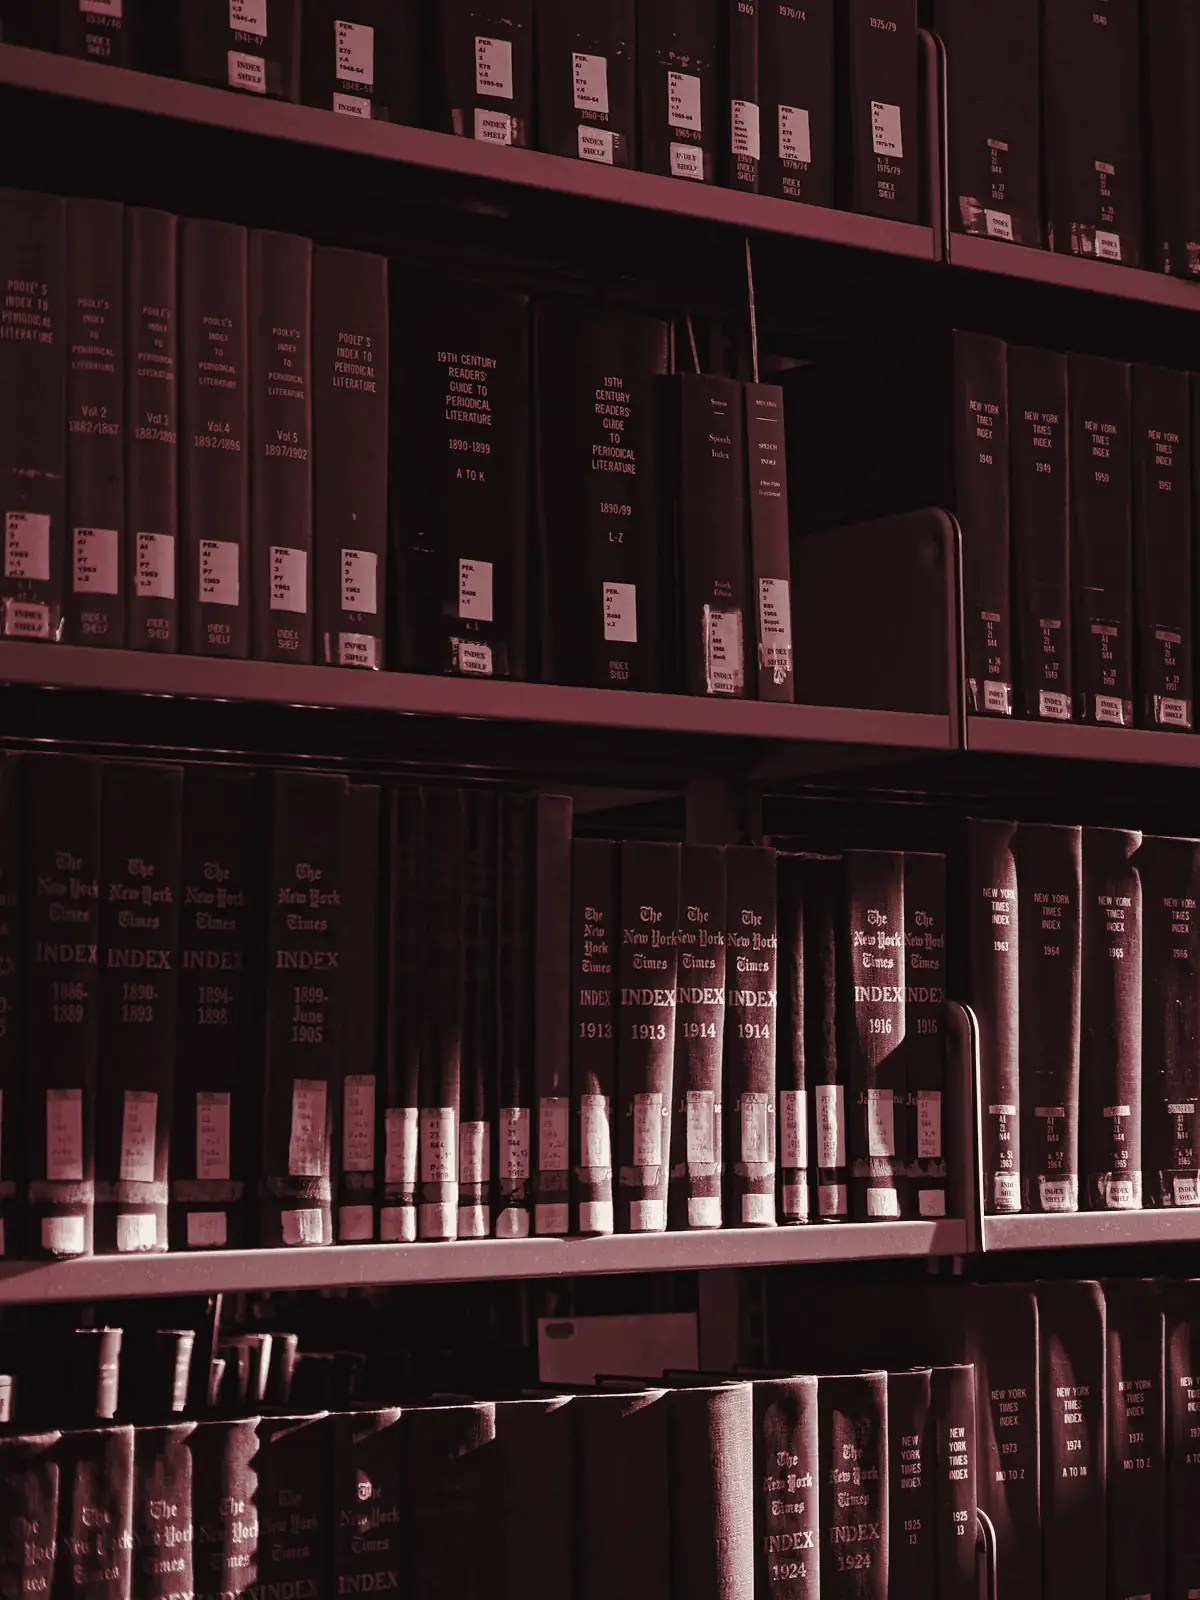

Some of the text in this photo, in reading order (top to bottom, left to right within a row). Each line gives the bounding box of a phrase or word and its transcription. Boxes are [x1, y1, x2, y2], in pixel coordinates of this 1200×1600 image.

[779, 5, 806, 22] 1970/74
[869, 17, 897, 32] 1975/79
[237, 61, 261, 72] INDEX
[237, 73, 262, 83] SHELF
[338, 103, 362, 115] INDEX
[482, 119, 507, 130] INDEX
[482, 130, 507, 141] SHELF
[582, 136, 604, 146] INDEX
[583, 147, 605, 157] SHELF
[877, 180, 896, 191] INDEX
[338, 331, 372, 348] POOLE'S
[337, 347, 372, 362] INDEX TO
[437, 351, 497, 369] 19TH CENTURY
[334, 361, 375, 378] PERIODICAL
[448, 366, 488, 381] READERS'
[332, 376, 376, 393] LITERATURE
[449, 380, 488, 397] GUIDE TO
[603, 376, 623, 389] 19TH
[445, 394, 492, 412] PERIODICAL
[595, 388, 631, 403] CENTURY
[445, 409, 492, 426] LITERATURE
[594, 403, 632, 418] READERS'
[1024, 411, 1060, 425] NEW YORK
[602, 418, 625, 431] GUIDE
[1033, 424, 1052, 435] TIMES
[1084, 420, 1117, 435] NEW YORK
[609, 432, 621, 444] TO
[708, 433, 731, 445] Speech
[1033, 437, 1052, 449] INDEX
[1092, 434, 1110, 446] TIMES
[265, 443, 307, 460] 1897/1902
[448, 438, 491, 455] 1890-1899
[592, 444, 636, 461] PERIODICAL
[1092, 447, 1110, 458] INDEX
[711, 449, 730, 460] Index
[456, 467, 485, 482] A TO K
[591, 459, 637, 475] LITERATURE
[1036, 462, 1052, 474] 1949
[1094, 471, 1110, 483] 1950
[600, 502, 632, 516] 1890/99
[608, 531, 624, 544] L-Z
[125, 857, 156, 879] The
[295, 862, 323, 883] The
[108, 883, 173, 908] New York
[278, 887, 341, 909] New York
[982, 887, 1016, 899] NEW YORK
[991, 901, 1010, 912] TIMES
[1098, 896, 1132, 907] NEW YORK
[118, 909, 161, 929] Times
[585, 906, 604, 922] The
[640, 905, 663, 923] The
[687, 905, 709, 923] The
[741, 909, 763, 927] The
[867, 909, 888, 926] The
[991, 914, 1010, 925] INDEX
[1105, 909, 1125, 920] TIMES
[286, 913, 328, 932] Times
[1106, 921, 1125, 932] INDEX
[584, 923, 605, 938] New
[623, 928, 678, 949] New York
[727, 932, 778, 951] New York
[854, 931, 902, 950] New York
[584, 940, 609, 958] York
[993, 941, 1009, 952] 1963
[1108, 947, 1124, 959] 1965
[107, 947, 172, 970] INDEX
[182, 950, 244, 970] INDEX
[275, 949, 340, 970] INDEX
[581, 959, 612, 973] Times
[632, 952, 668, 970] Times
[682, 953, 716, 969] Times
[736, 955, 769, 972] Times
[862, 953, 894, 968] Times
[580, 989, 612, 1007] INDEX
[621, 988, 676, 1007] INDEX
[728, 989, 777, 1007] INDEX
[854, 986, 903, 1002] INDEX
[121, 1003, 153, 1024] 1893
[198, 1007, 228, 1025] 1898
[292, 1004, 324, 1024] June
[579, 1022, 612, 1039] 1913
[631, 1024, 666, 1040] 1913
[683, 1022, 716, 1038] 1914
[737, 1023, 770, 1039] 1914
[869, 1018, 892, 1034] 1916
[291, 1025, 323, 1043] 1905
[1056, 1386, 1090, 1398] NEW YORK
[1064, 1400, 1083, 1410] TIMES
[1064, 1413, 1082, 1424] INDEX
[950, 1427, 965, 1438] NEW
[950, 1441, 967, 1452] YORK
[1066, 1440, 1082, 1451] 1974
[776, 1450, 799, 1469] The
[949, 1455, 968, 1466] TIMES
[949, 1468, 968, 1480] INDEX
[1062, 1467, 1068, 1478] A
[1069, 1467, 1078, 1477] TO
[771, 1499, 805, 1516] Times
[952, 1510, 968, 1521] 1925
[956, 1524, 965, 1535] 13
[766, 1531, 814, 1553] INDEX
[772, 1562, 807, 1581] 1924
